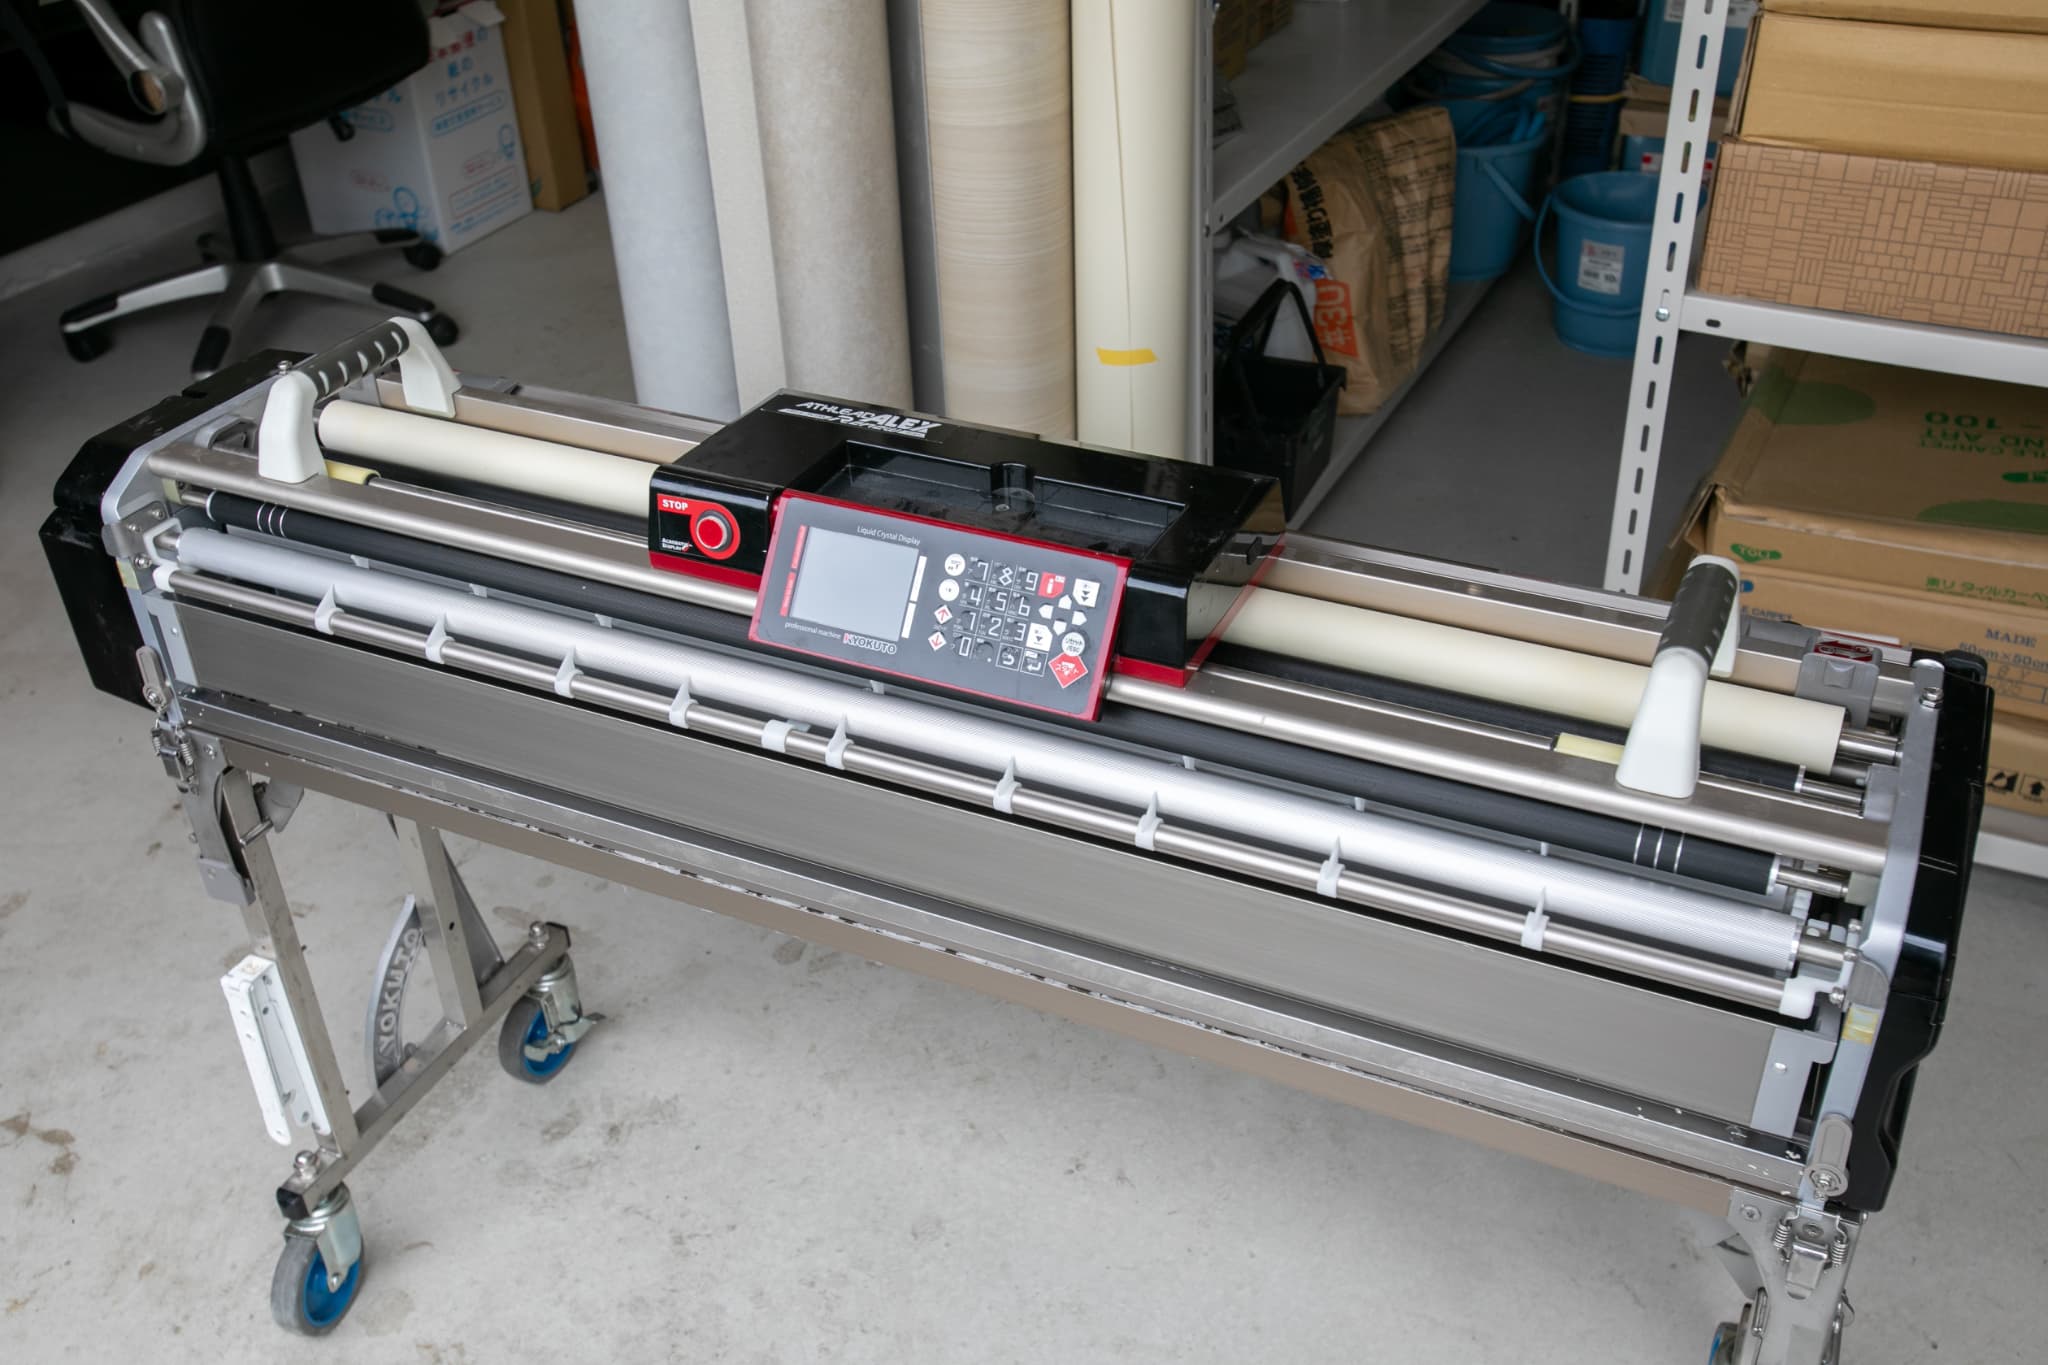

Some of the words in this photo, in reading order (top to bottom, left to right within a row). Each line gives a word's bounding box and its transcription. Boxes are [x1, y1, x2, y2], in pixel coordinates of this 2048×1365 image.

[864, 413, 943, 434] ALEX
[661, 498, 689, 512] STOP
[856, 525, 877, 537] Liquid
[876, 529, 898, 542] Crystal
[897, 533, 921, 547] Display
[977, 561, 989, 582] 7
[997, 566, 1014, 587] 8
[1024, 571, 1040, 592] 9
[970, 586, 983, 607] 4
[994, 591, 1009, 612] 5
[1018, 597, 1032, 617] 6
[785, 621, 818, 635] professional
[818, 629, 842, 641] machine
[843, 633, 897, 655] KYOKUTO
[969, 612, 977, 631] 1
[987, 616, 1003, 637] 2
[1014, 622, 1027, 642] 3
[959, 636, 972, 657] 0
[1985, 628, 2037, 649] MADE
